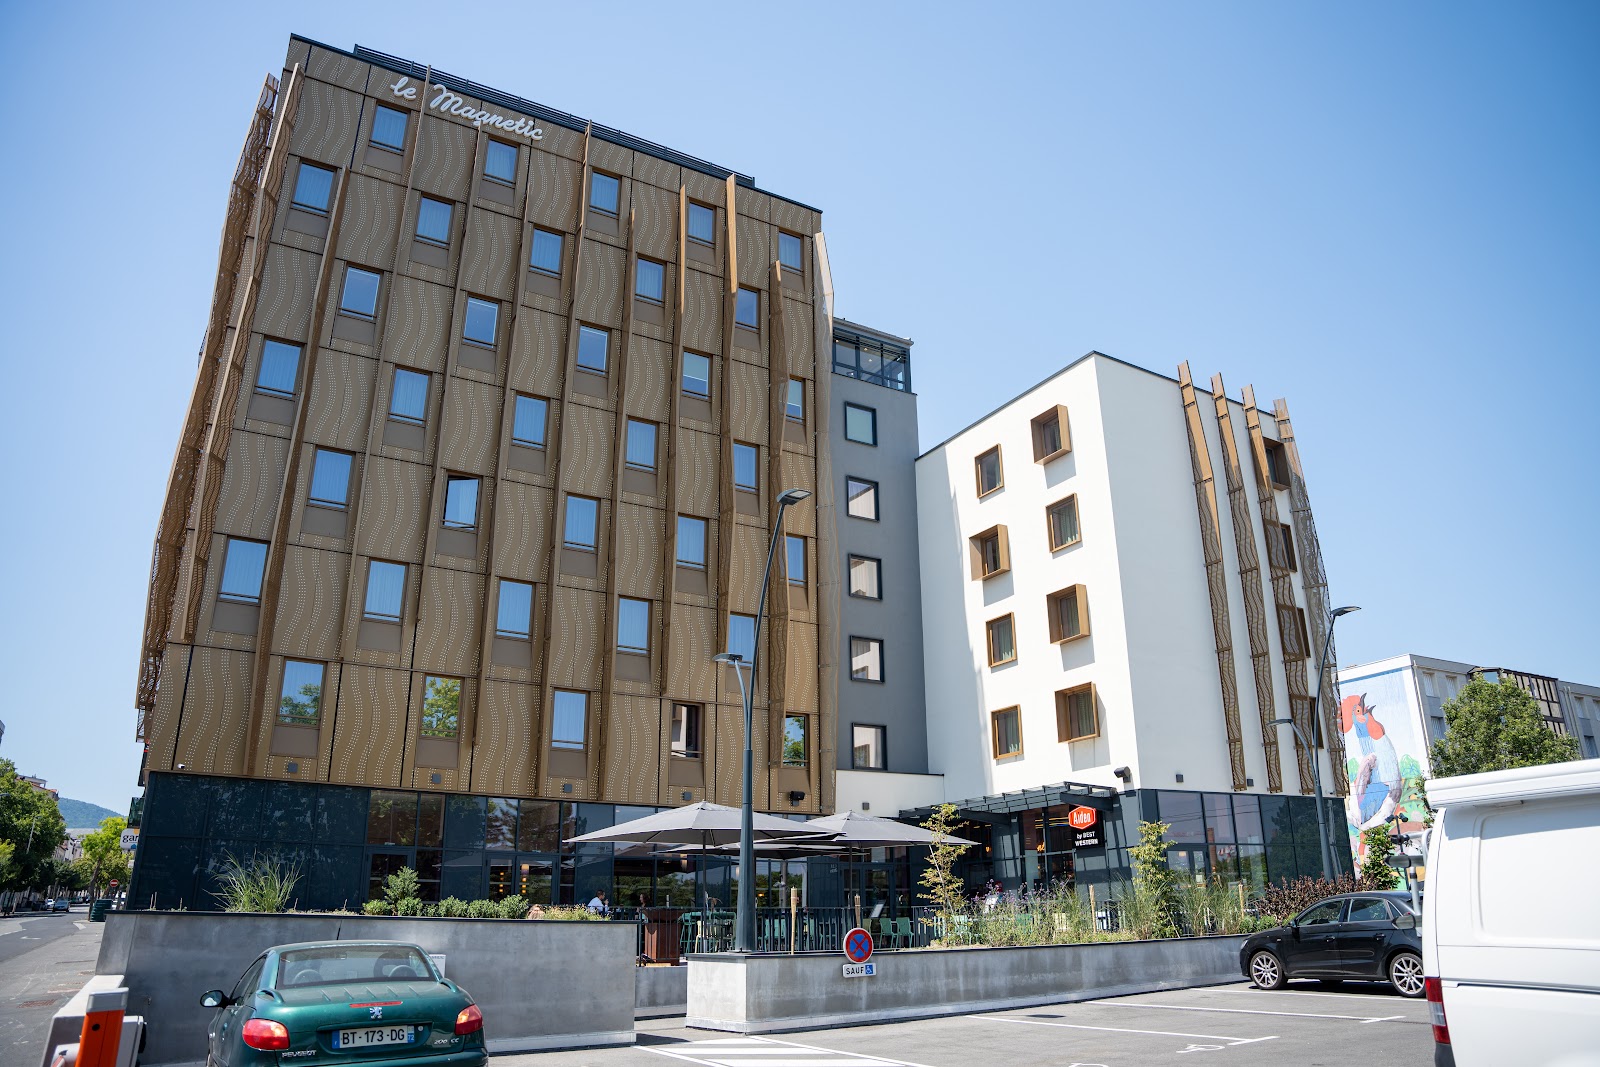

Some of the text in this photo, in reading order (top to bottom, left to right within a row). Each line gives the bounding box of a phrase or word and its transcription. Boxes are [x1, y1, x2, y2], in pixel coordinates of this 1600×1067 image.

[429, 83, 543, 141] Magnetic
[1073, 811, 1091, 825] Aiden
[1075, 838, 1099, 847] WESTERN
[846, 966, 864, 975] SAUF
